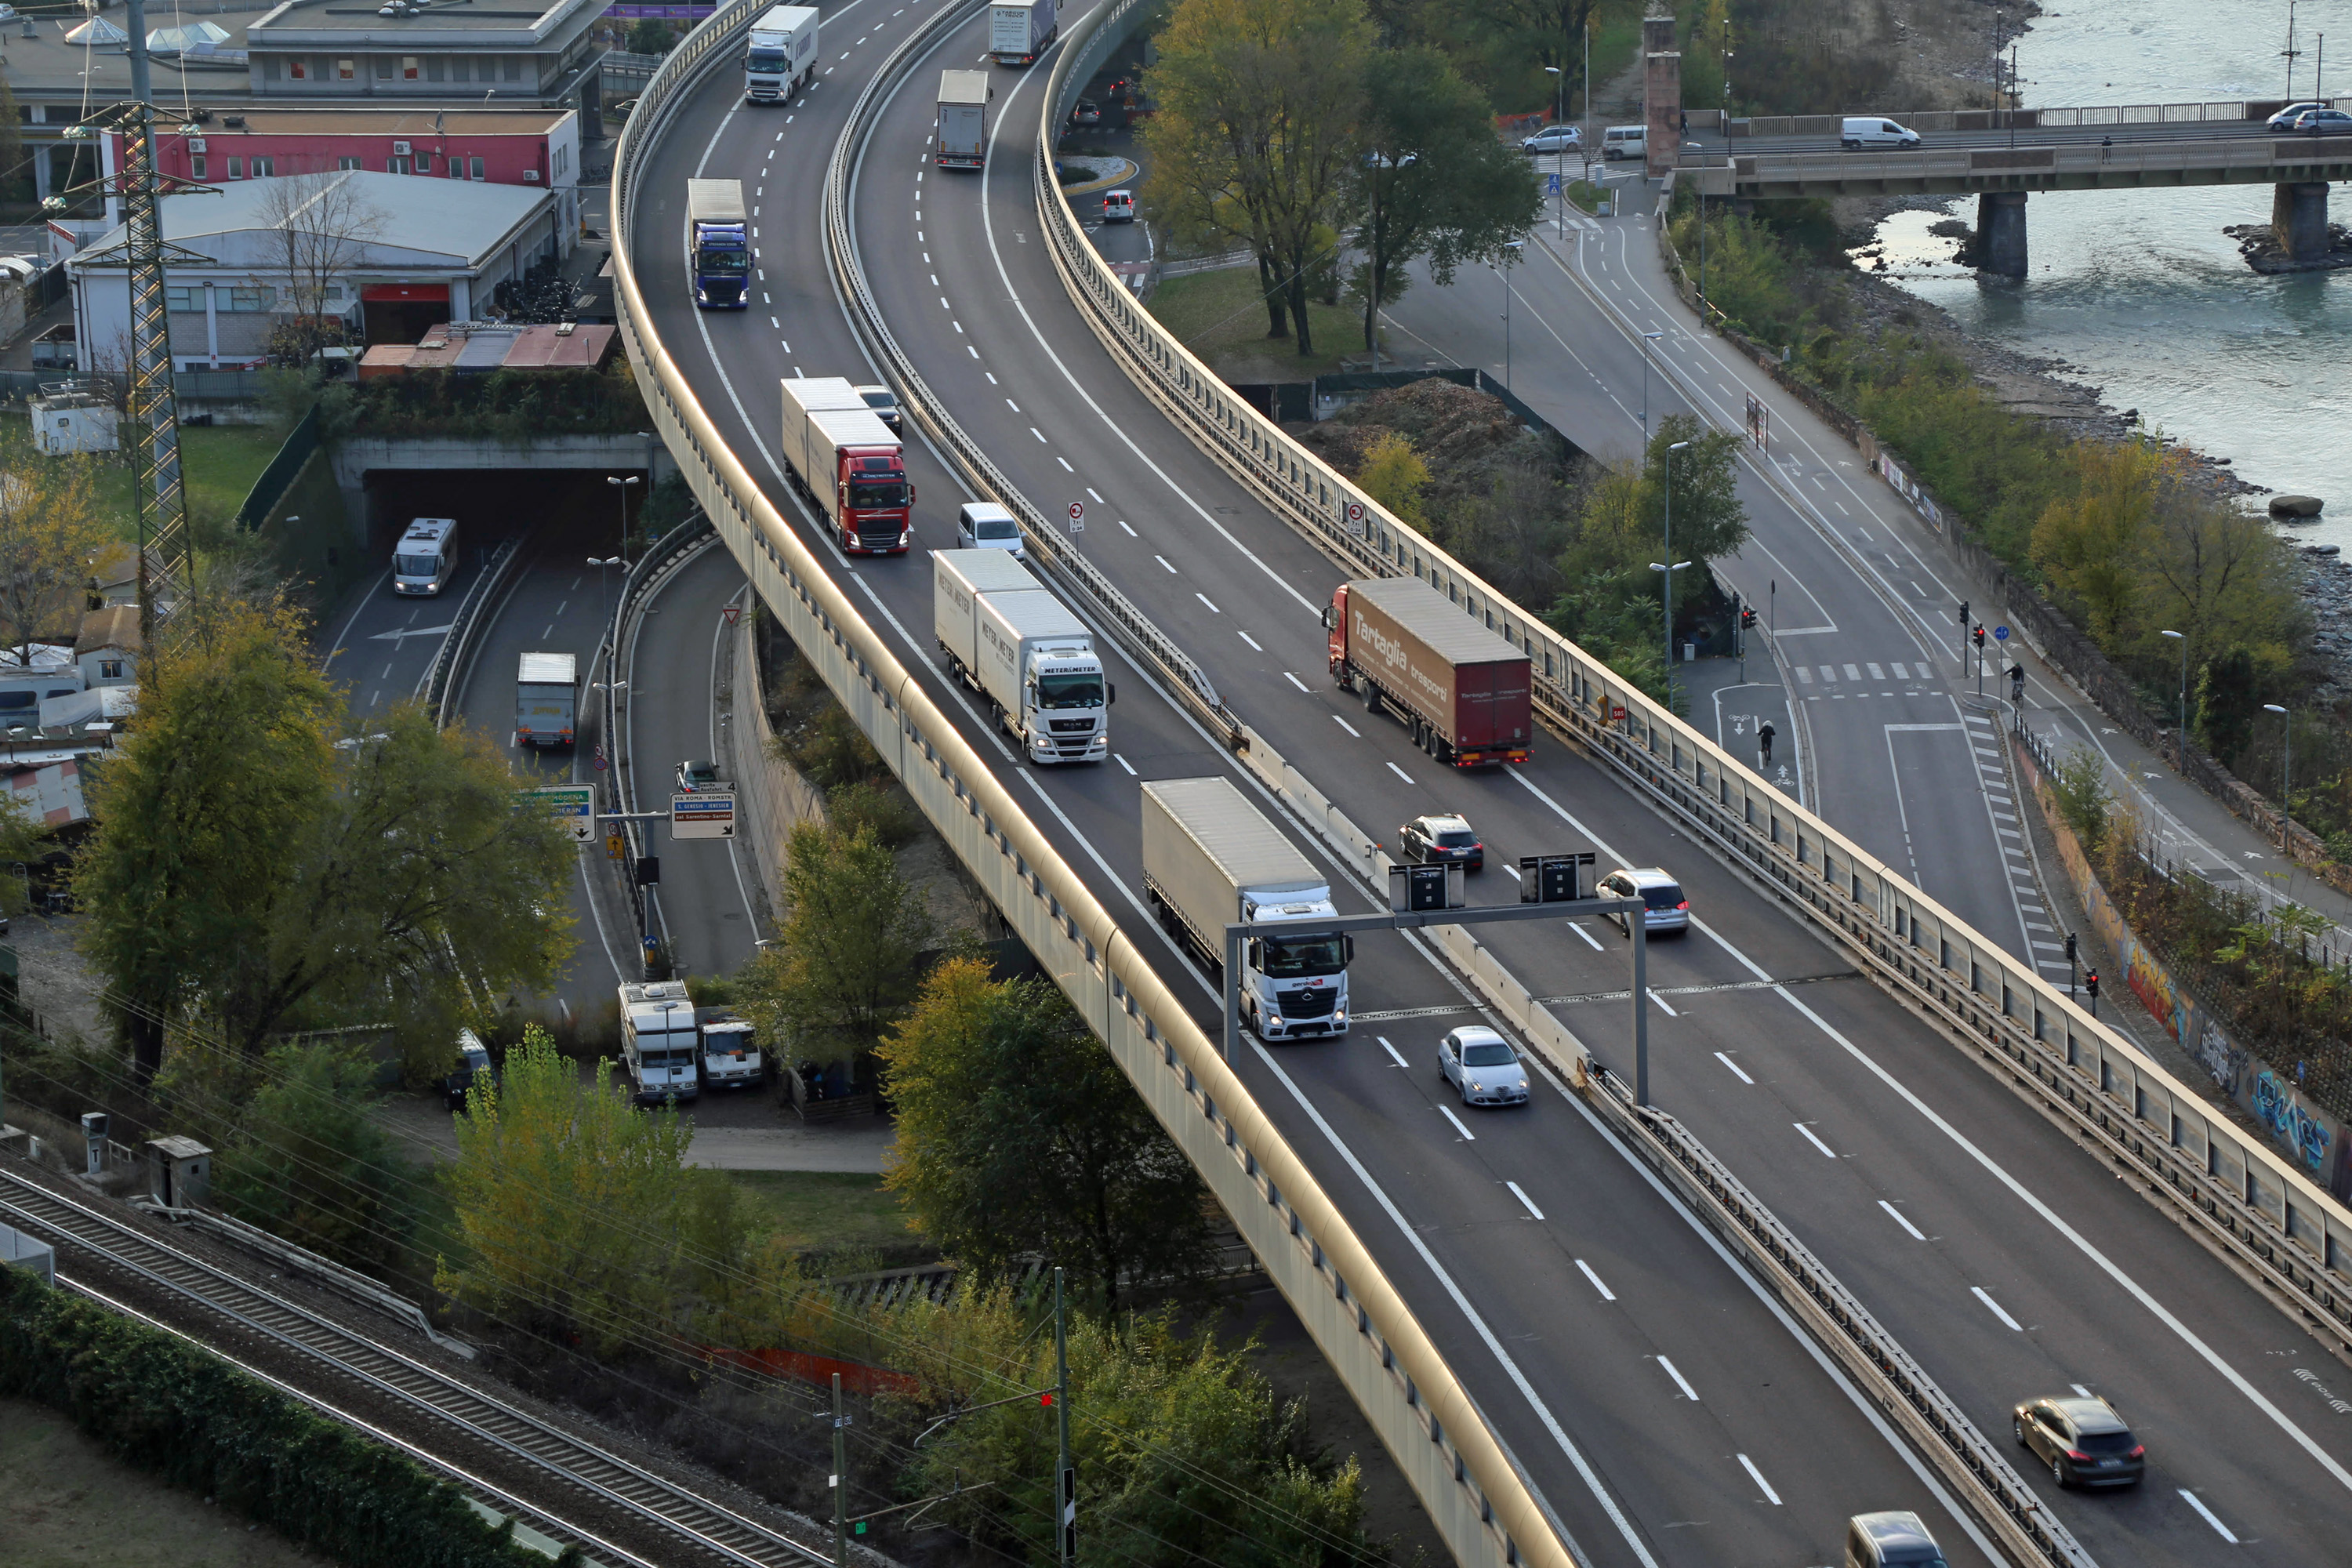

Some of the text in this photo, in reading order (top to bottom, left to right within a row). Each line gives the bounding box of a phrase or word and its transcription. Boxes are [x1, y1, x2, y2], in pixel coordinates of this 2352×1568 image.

[1355, 609, 1407, 671] Tartaglia
[1410, 663, 1447, 702] trasporti
[728, 782, 736, 791] 4
[92, 1149, 99, 1163] T
[2311, 1381, 2334, 1399] SOS
